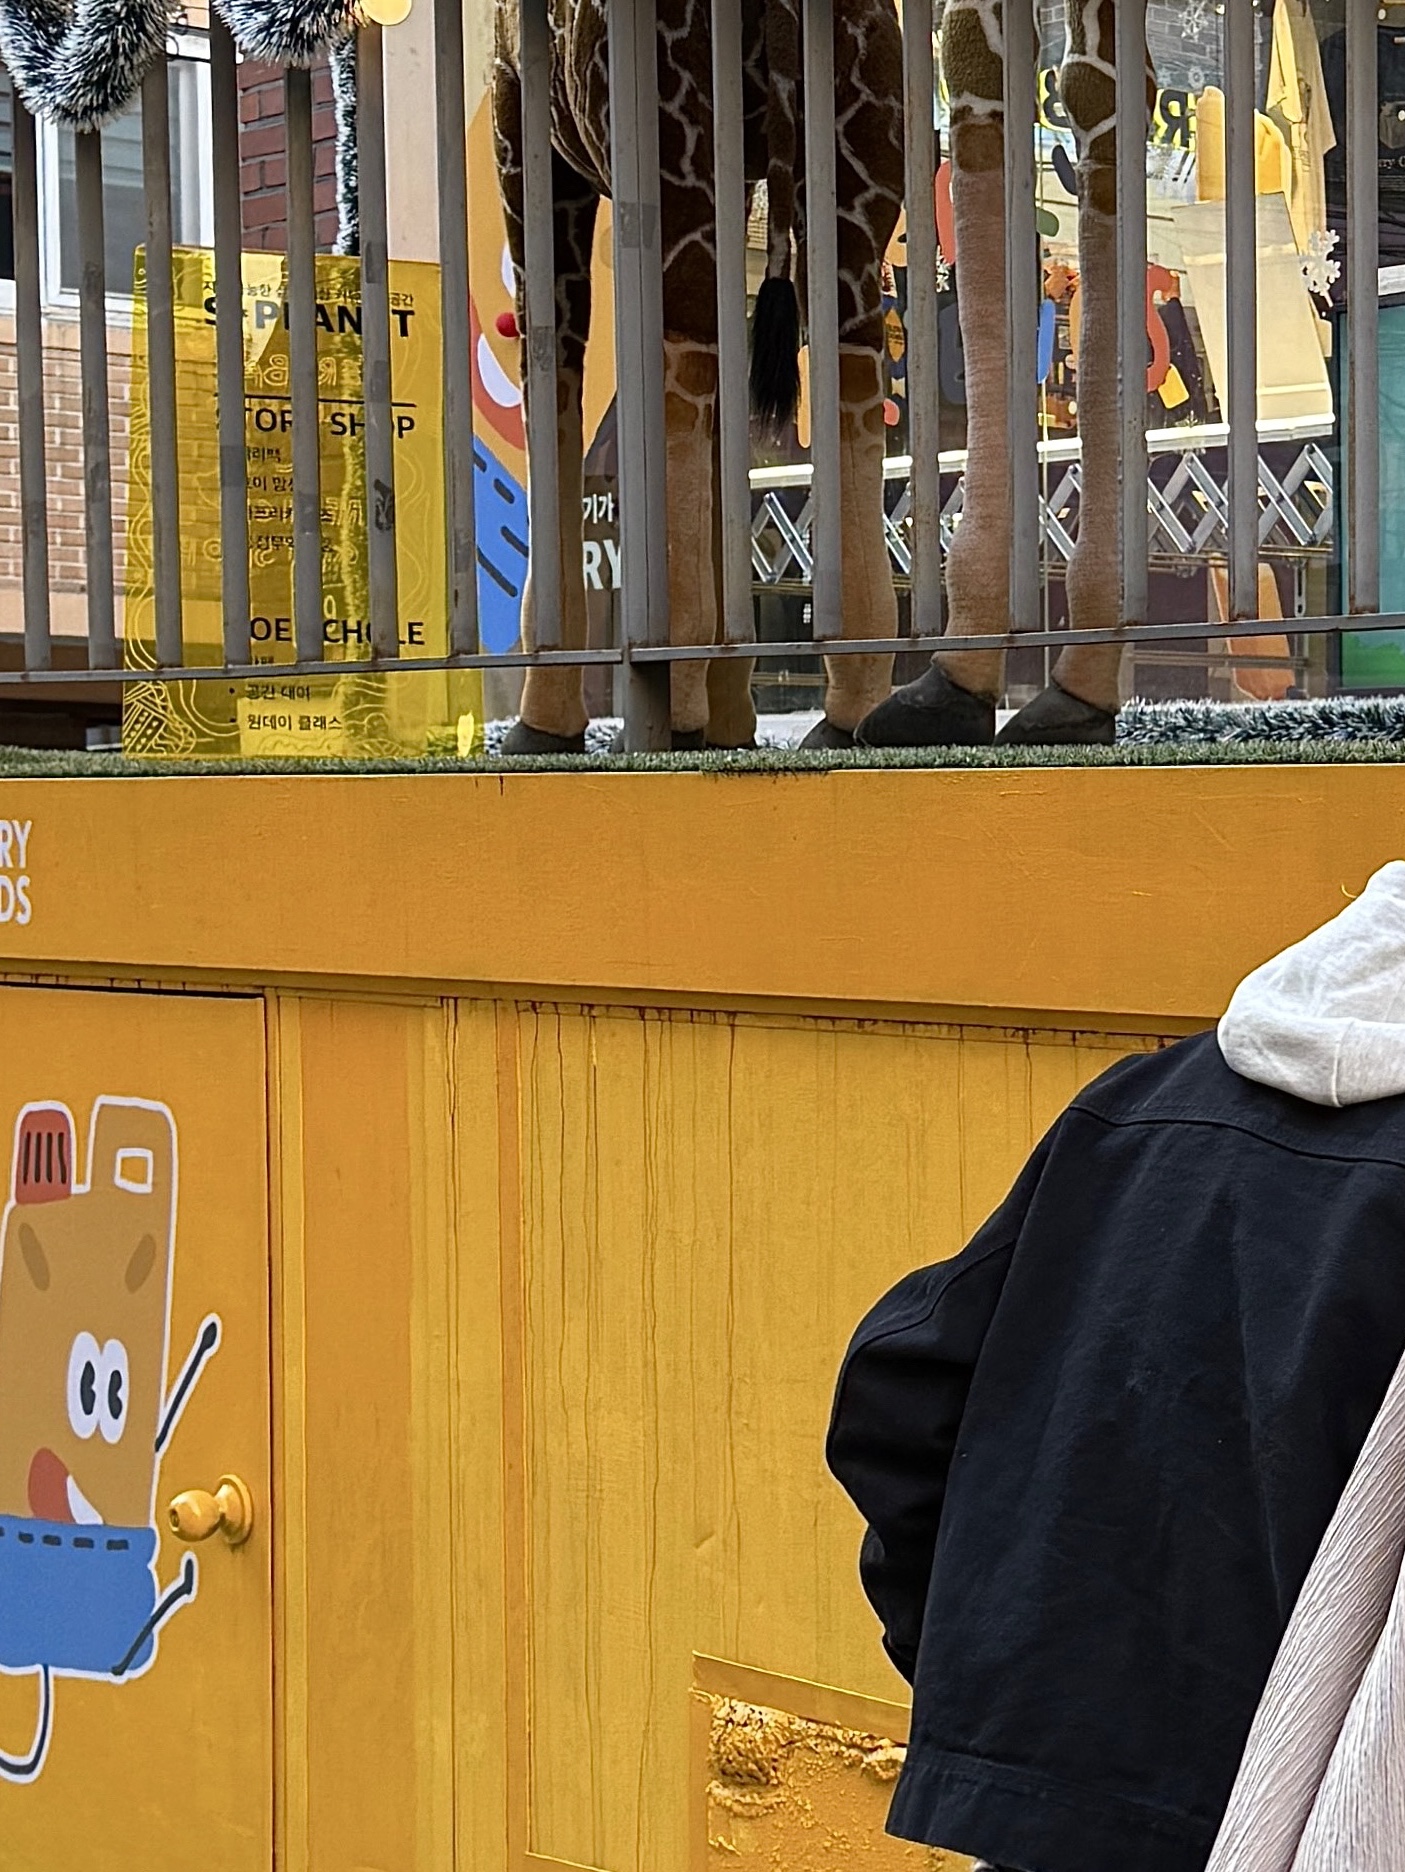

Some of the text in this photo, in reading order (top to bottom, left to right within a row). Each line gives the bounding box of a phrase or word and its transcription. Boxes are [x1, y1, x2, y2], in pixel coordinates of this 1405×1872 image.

[330, 411, 415, 439] SHP
[248, 713, 343, 731] 원데이 클래스
